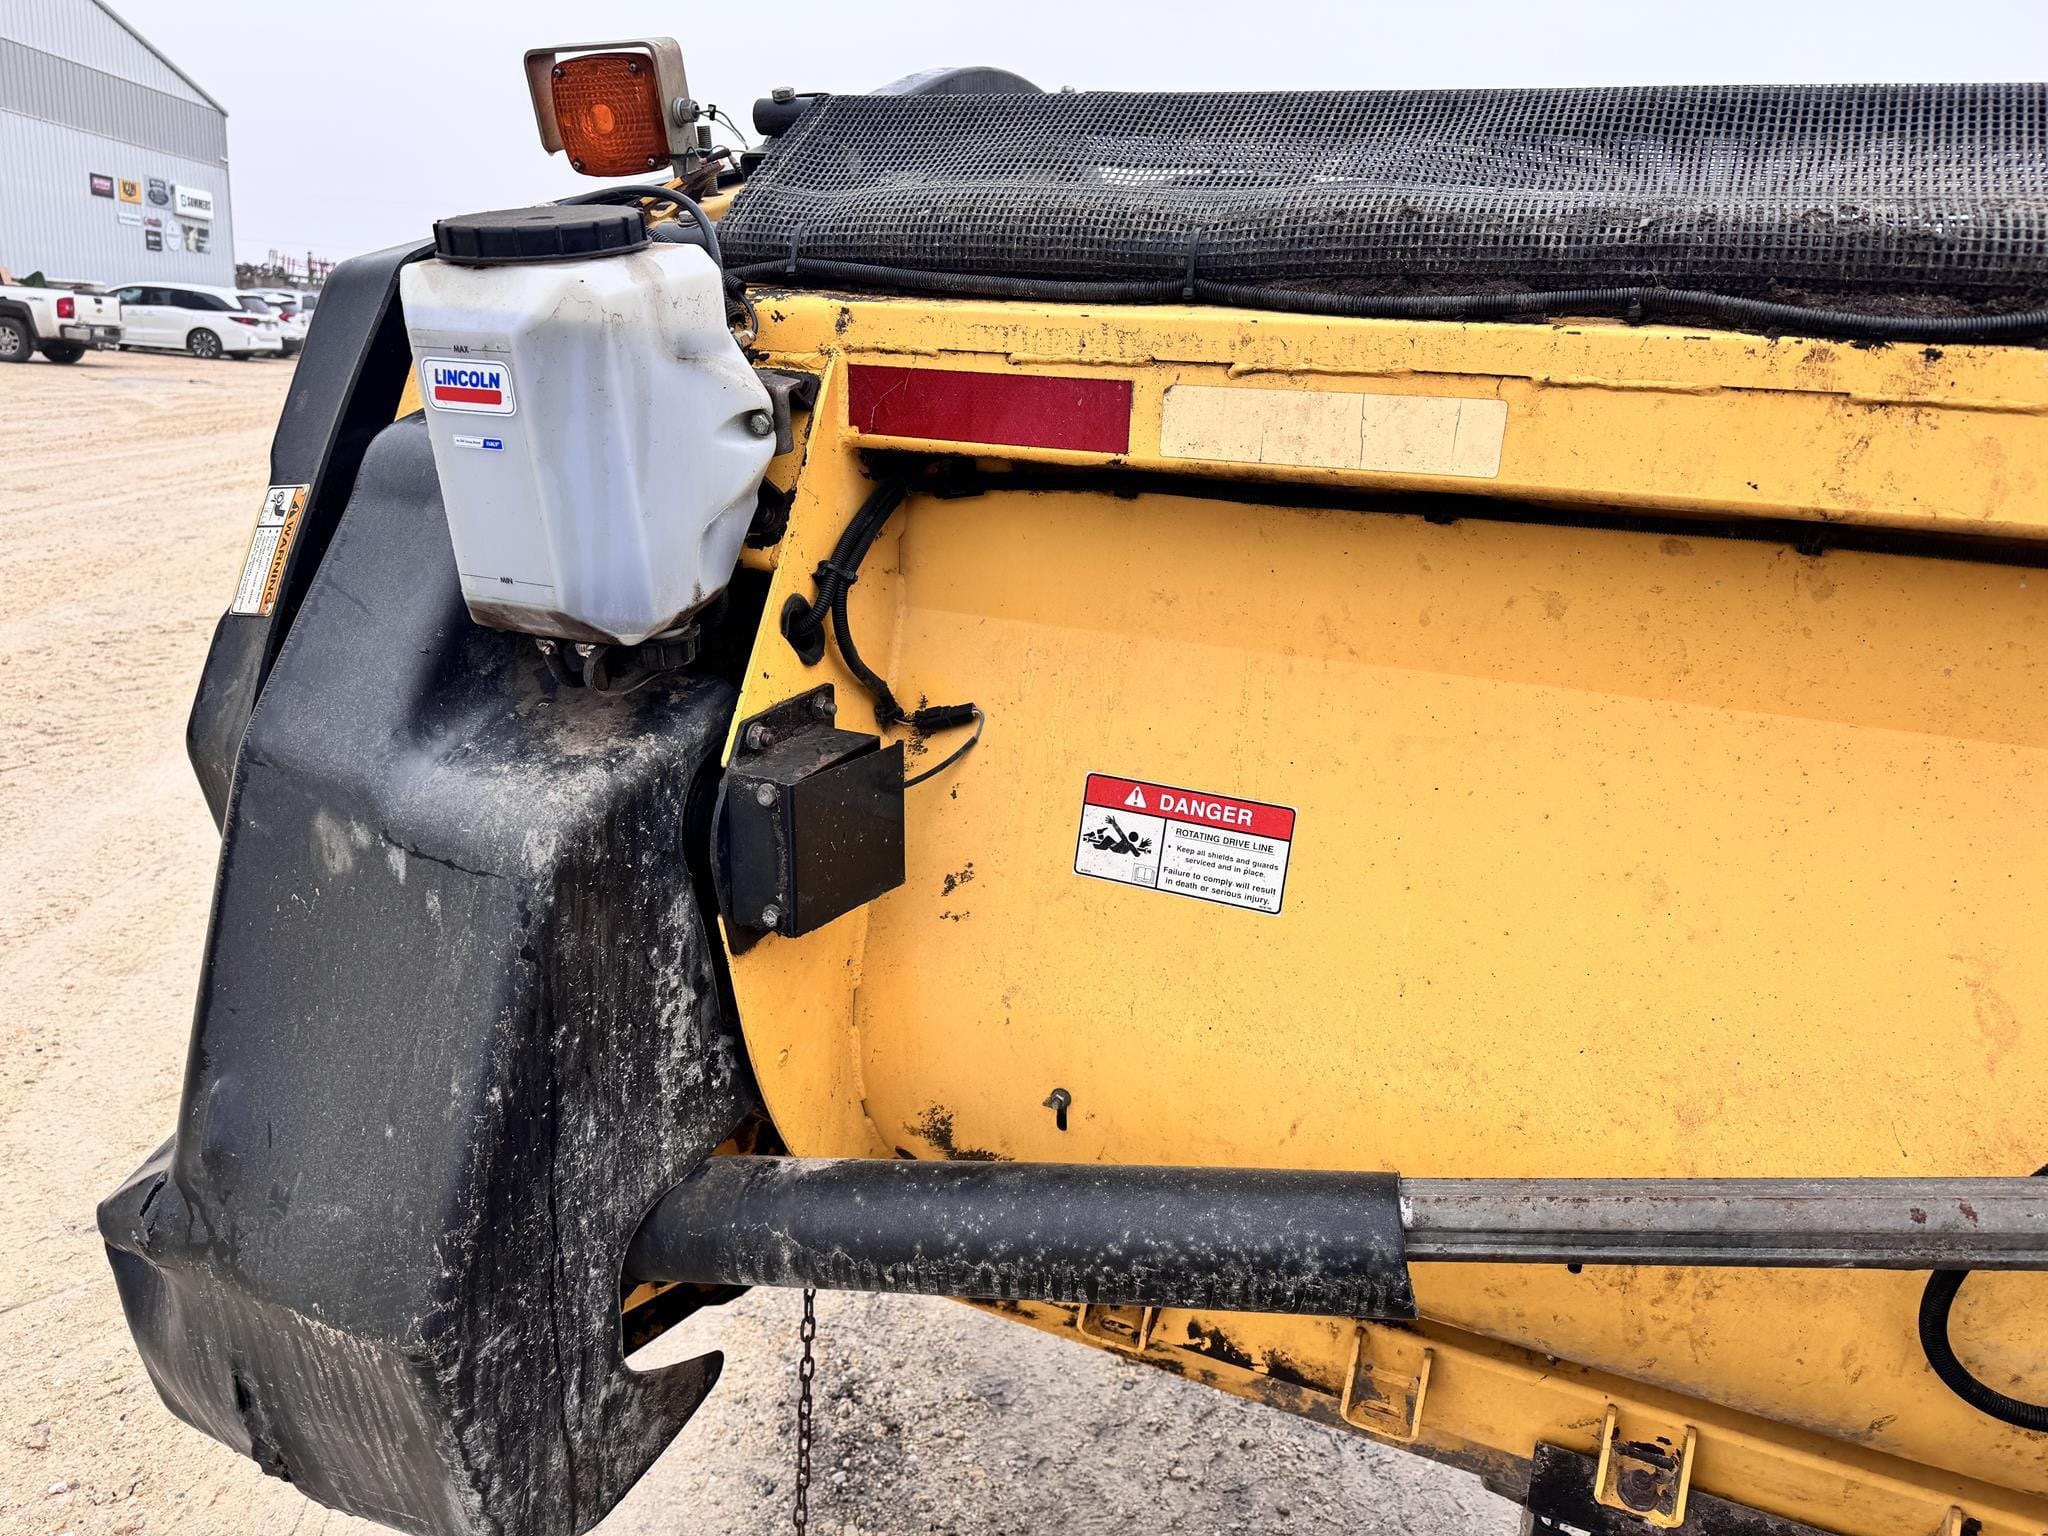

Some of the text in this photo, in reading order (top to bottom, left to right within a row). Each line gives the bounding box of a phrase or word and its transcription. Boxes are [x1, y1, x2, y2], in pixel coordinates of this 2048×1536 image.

[187, 196, 211, 211] SUMMERS
[453, 344, 470, 354] MAX
[434, 368, 500, 389] LINCOLN
[264, 521, 294, 605] WARNING
[499, 576, 514, 586] MIN
[1160, 794, 1253, 826] DANGER
[1175, 827, 1275, 853] ROTATING DRIVE LINE
[1176, 845, 1279, 871] Keep all shields and guards
[1185, 856, 1216, 869] serviced
[1218, 862, 1232, 872] and
[1243, 867, 1266, 879] place.
[1163, 866, 1276, 895] Failure to comply will result
[1165, 877, 1173, 885] in
[1175, 879, 1198, 890] death
[1212, 886, 1242, 899] serious
[1244, 891, 1270, 905] injury.
